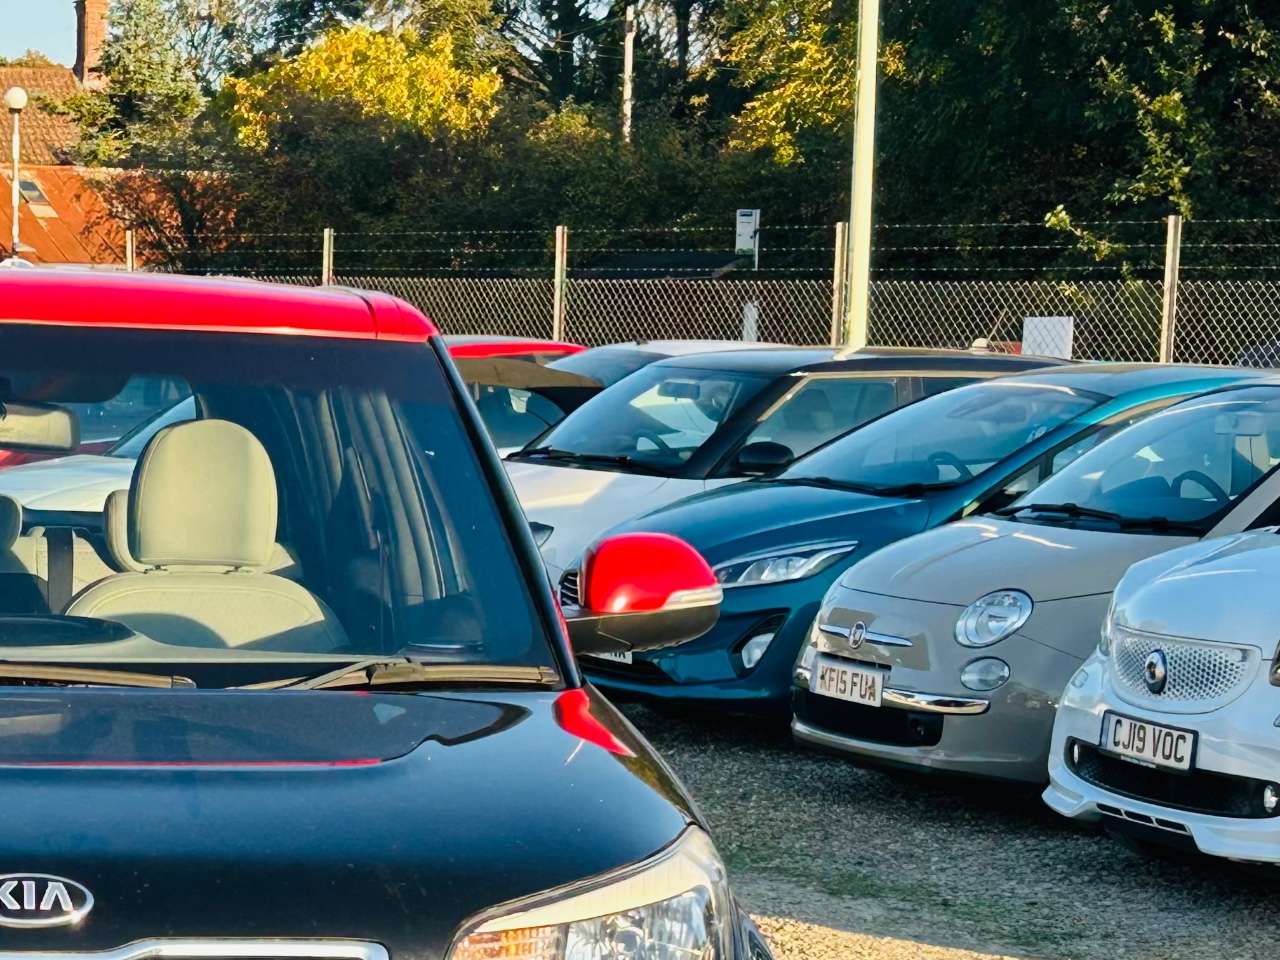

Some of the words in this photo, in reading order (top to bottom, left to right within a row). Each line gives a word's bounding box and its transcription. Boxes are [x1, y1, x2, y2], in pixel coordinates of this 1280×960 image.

[820, 664, 848, 695] KF15
[850, 672, 876, 702] FUA
[1113, 719, 1147, 754] CJ19
[1152, 727, 1187, 763] VOC
